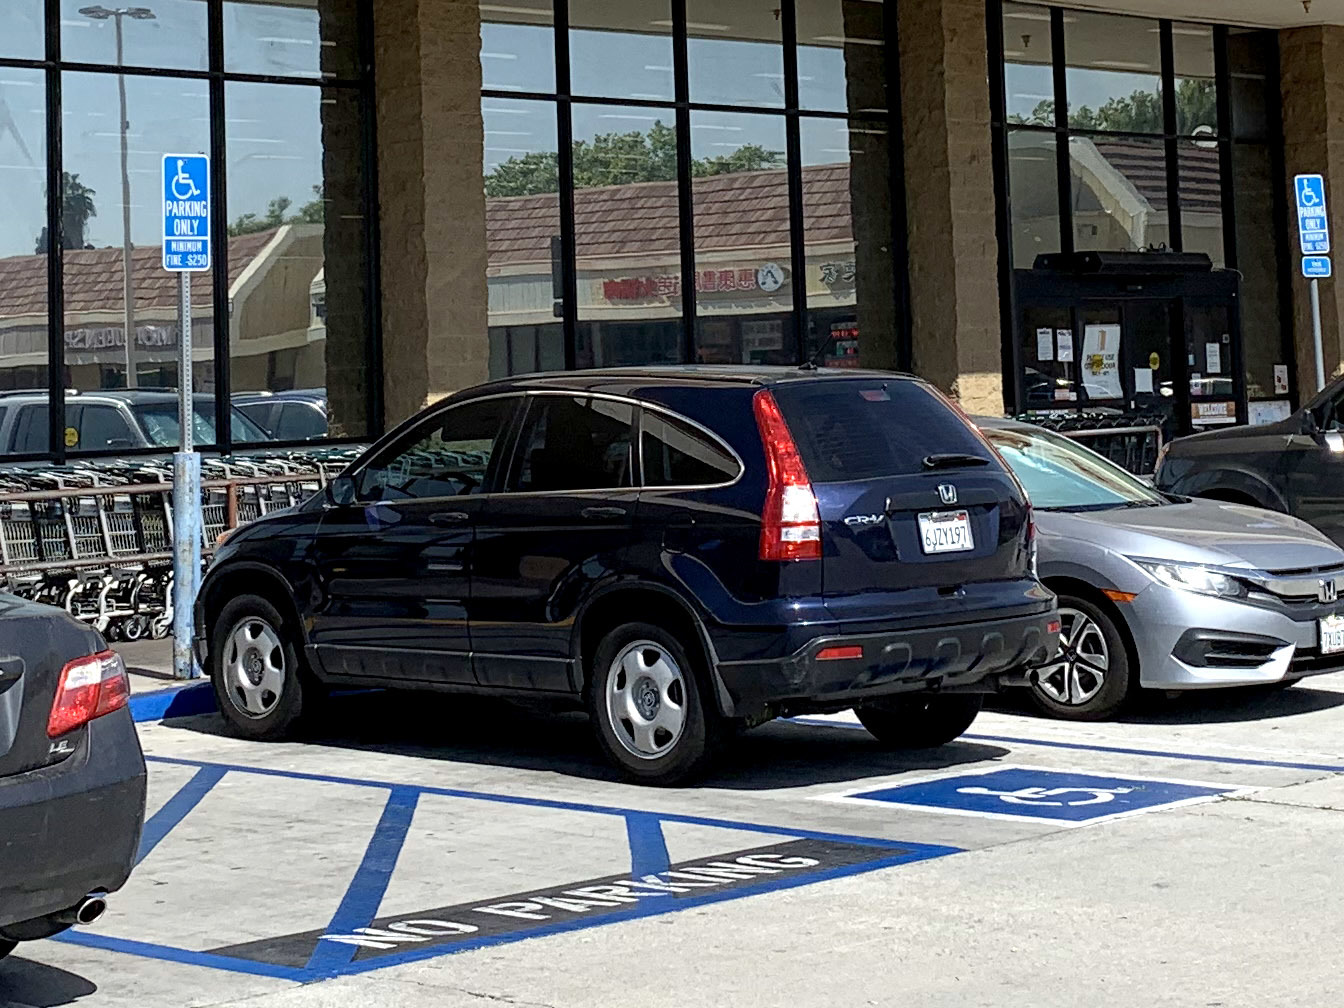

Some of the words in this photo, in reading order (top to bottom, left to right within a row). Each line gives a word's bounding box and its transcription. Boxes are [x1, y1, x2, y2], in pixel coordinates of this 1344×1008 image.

[166, 200, 207, 217] PARKING
[173, 218, 199, 236] ONLY
[171, 241, 202, 252] MINIMUM
[166, 254, 182, 266] FINE
[925, 525, 967, 547] 6JZY197
[49, 739, 69, 754] LE
[318, 918, 479, 950] NO
[472, 853, 821, 921] PARKING
